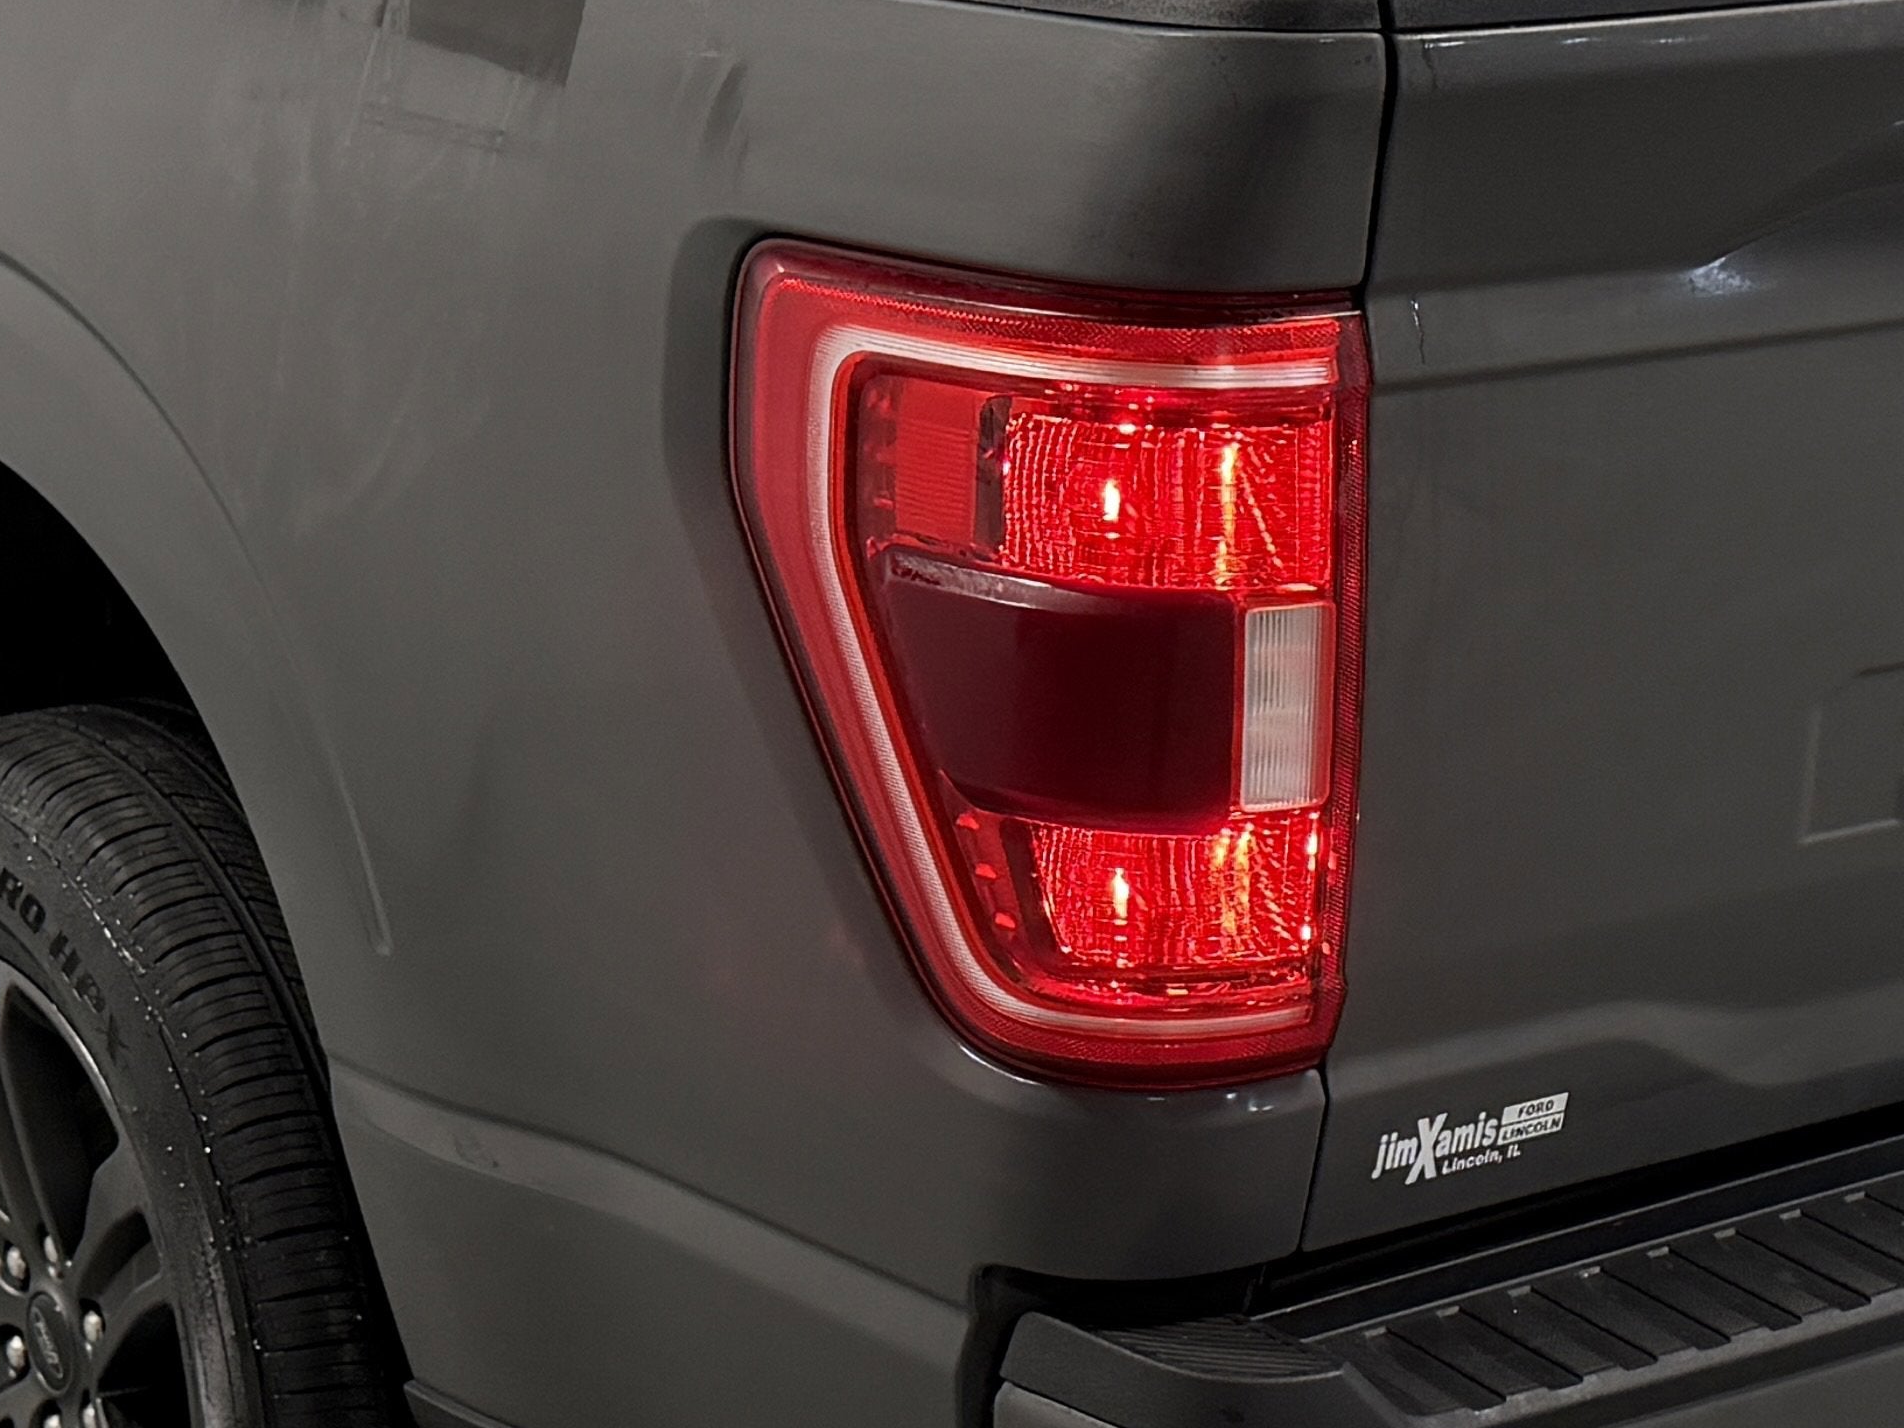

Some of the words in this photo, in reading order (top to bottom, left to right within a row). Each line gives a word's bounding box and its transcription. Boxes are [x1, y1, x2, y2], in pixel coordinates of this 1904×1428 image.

[1517, 1099, 1555, 1119] FORD
[1501, 1115, 1562, 1142] LINCOLN
[1442, 1148, 1503, 1175] Lincoln,
[1507, 1144, 1521, 1159] IL
